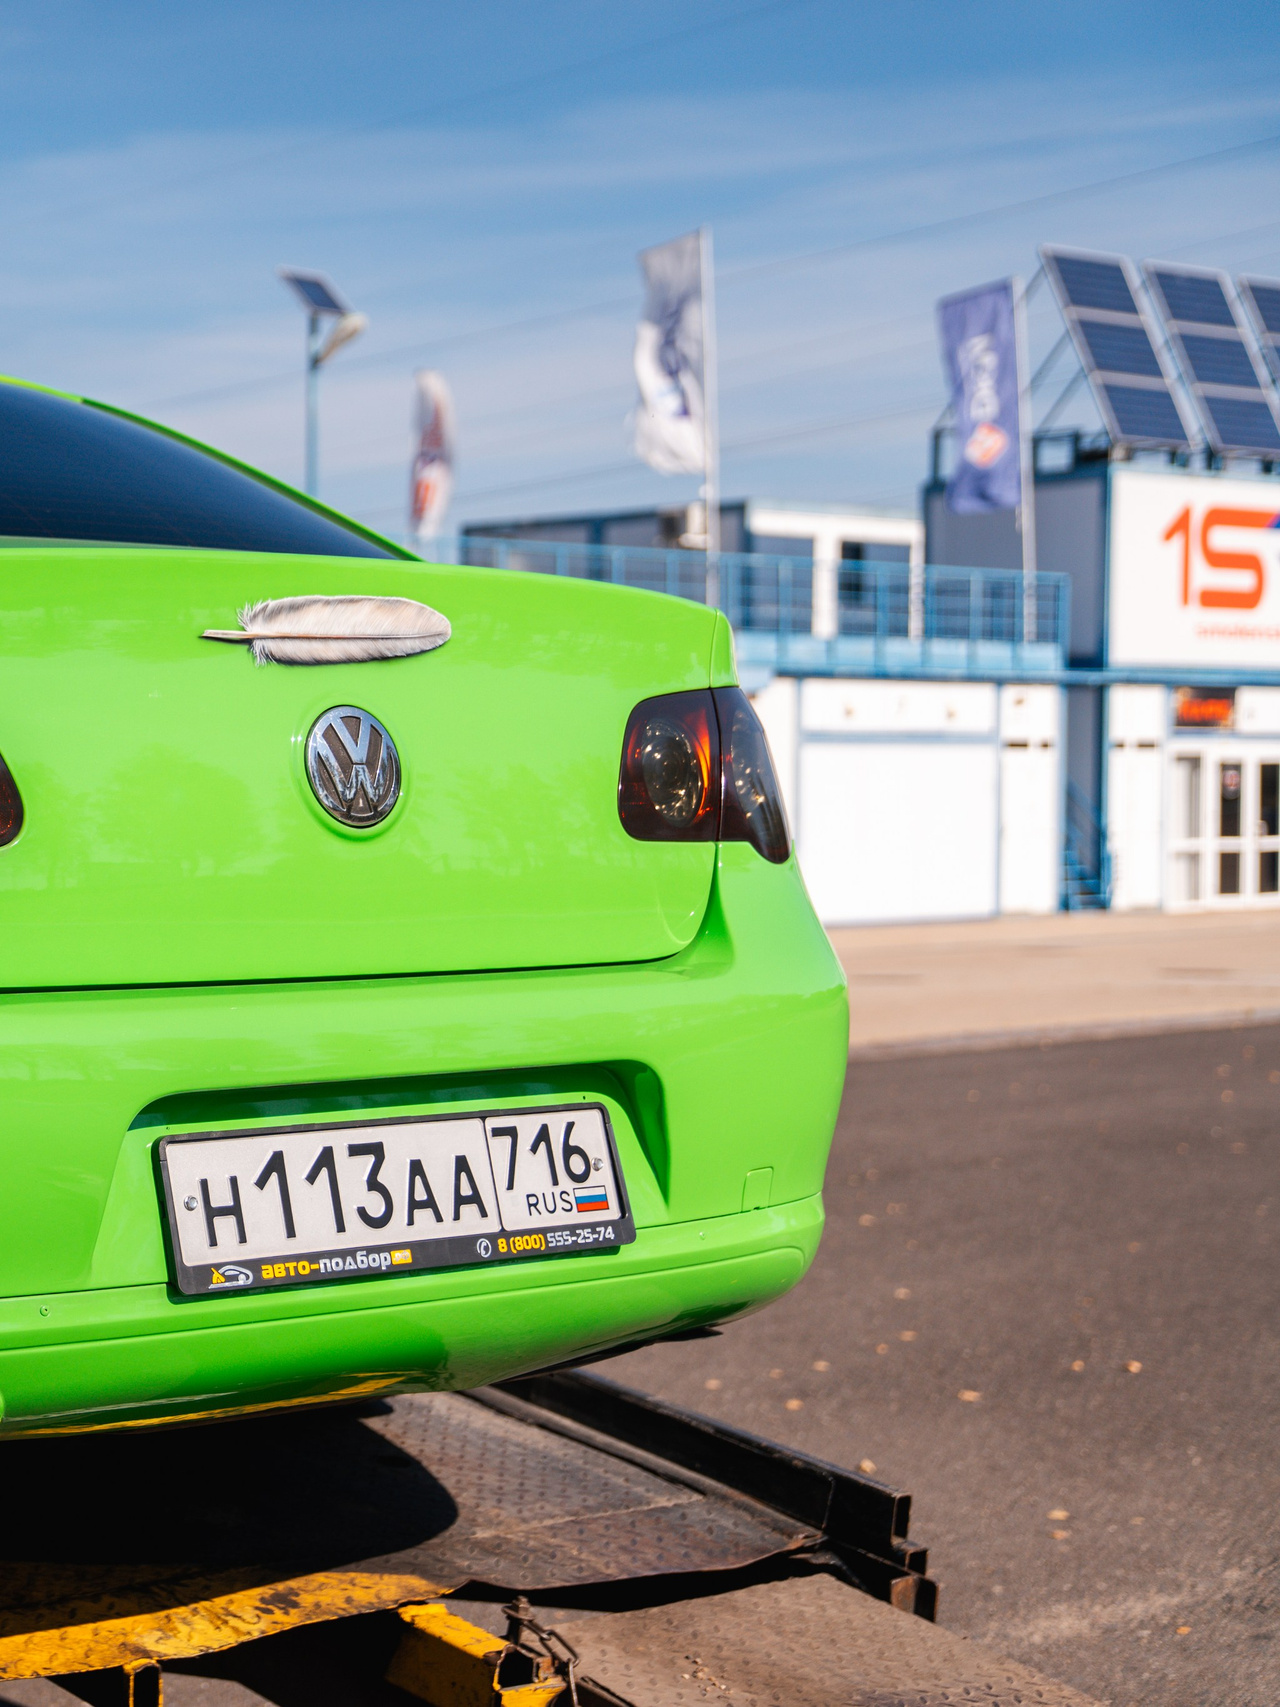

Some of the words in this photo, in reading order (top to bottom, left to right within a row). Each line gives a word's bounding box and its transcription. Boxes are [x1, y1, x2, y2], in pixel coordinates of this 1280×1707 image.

[1163, 506, 1280, 610] 1S
[491, 1120, 592, 1191] 716
[525, 1190, 573, 1216] RUS
[497, 1238, 508, 1253] 8
[510, 1233, 546, 1254] (800)
[546, 1225, 615, 1247] 555-25-74
